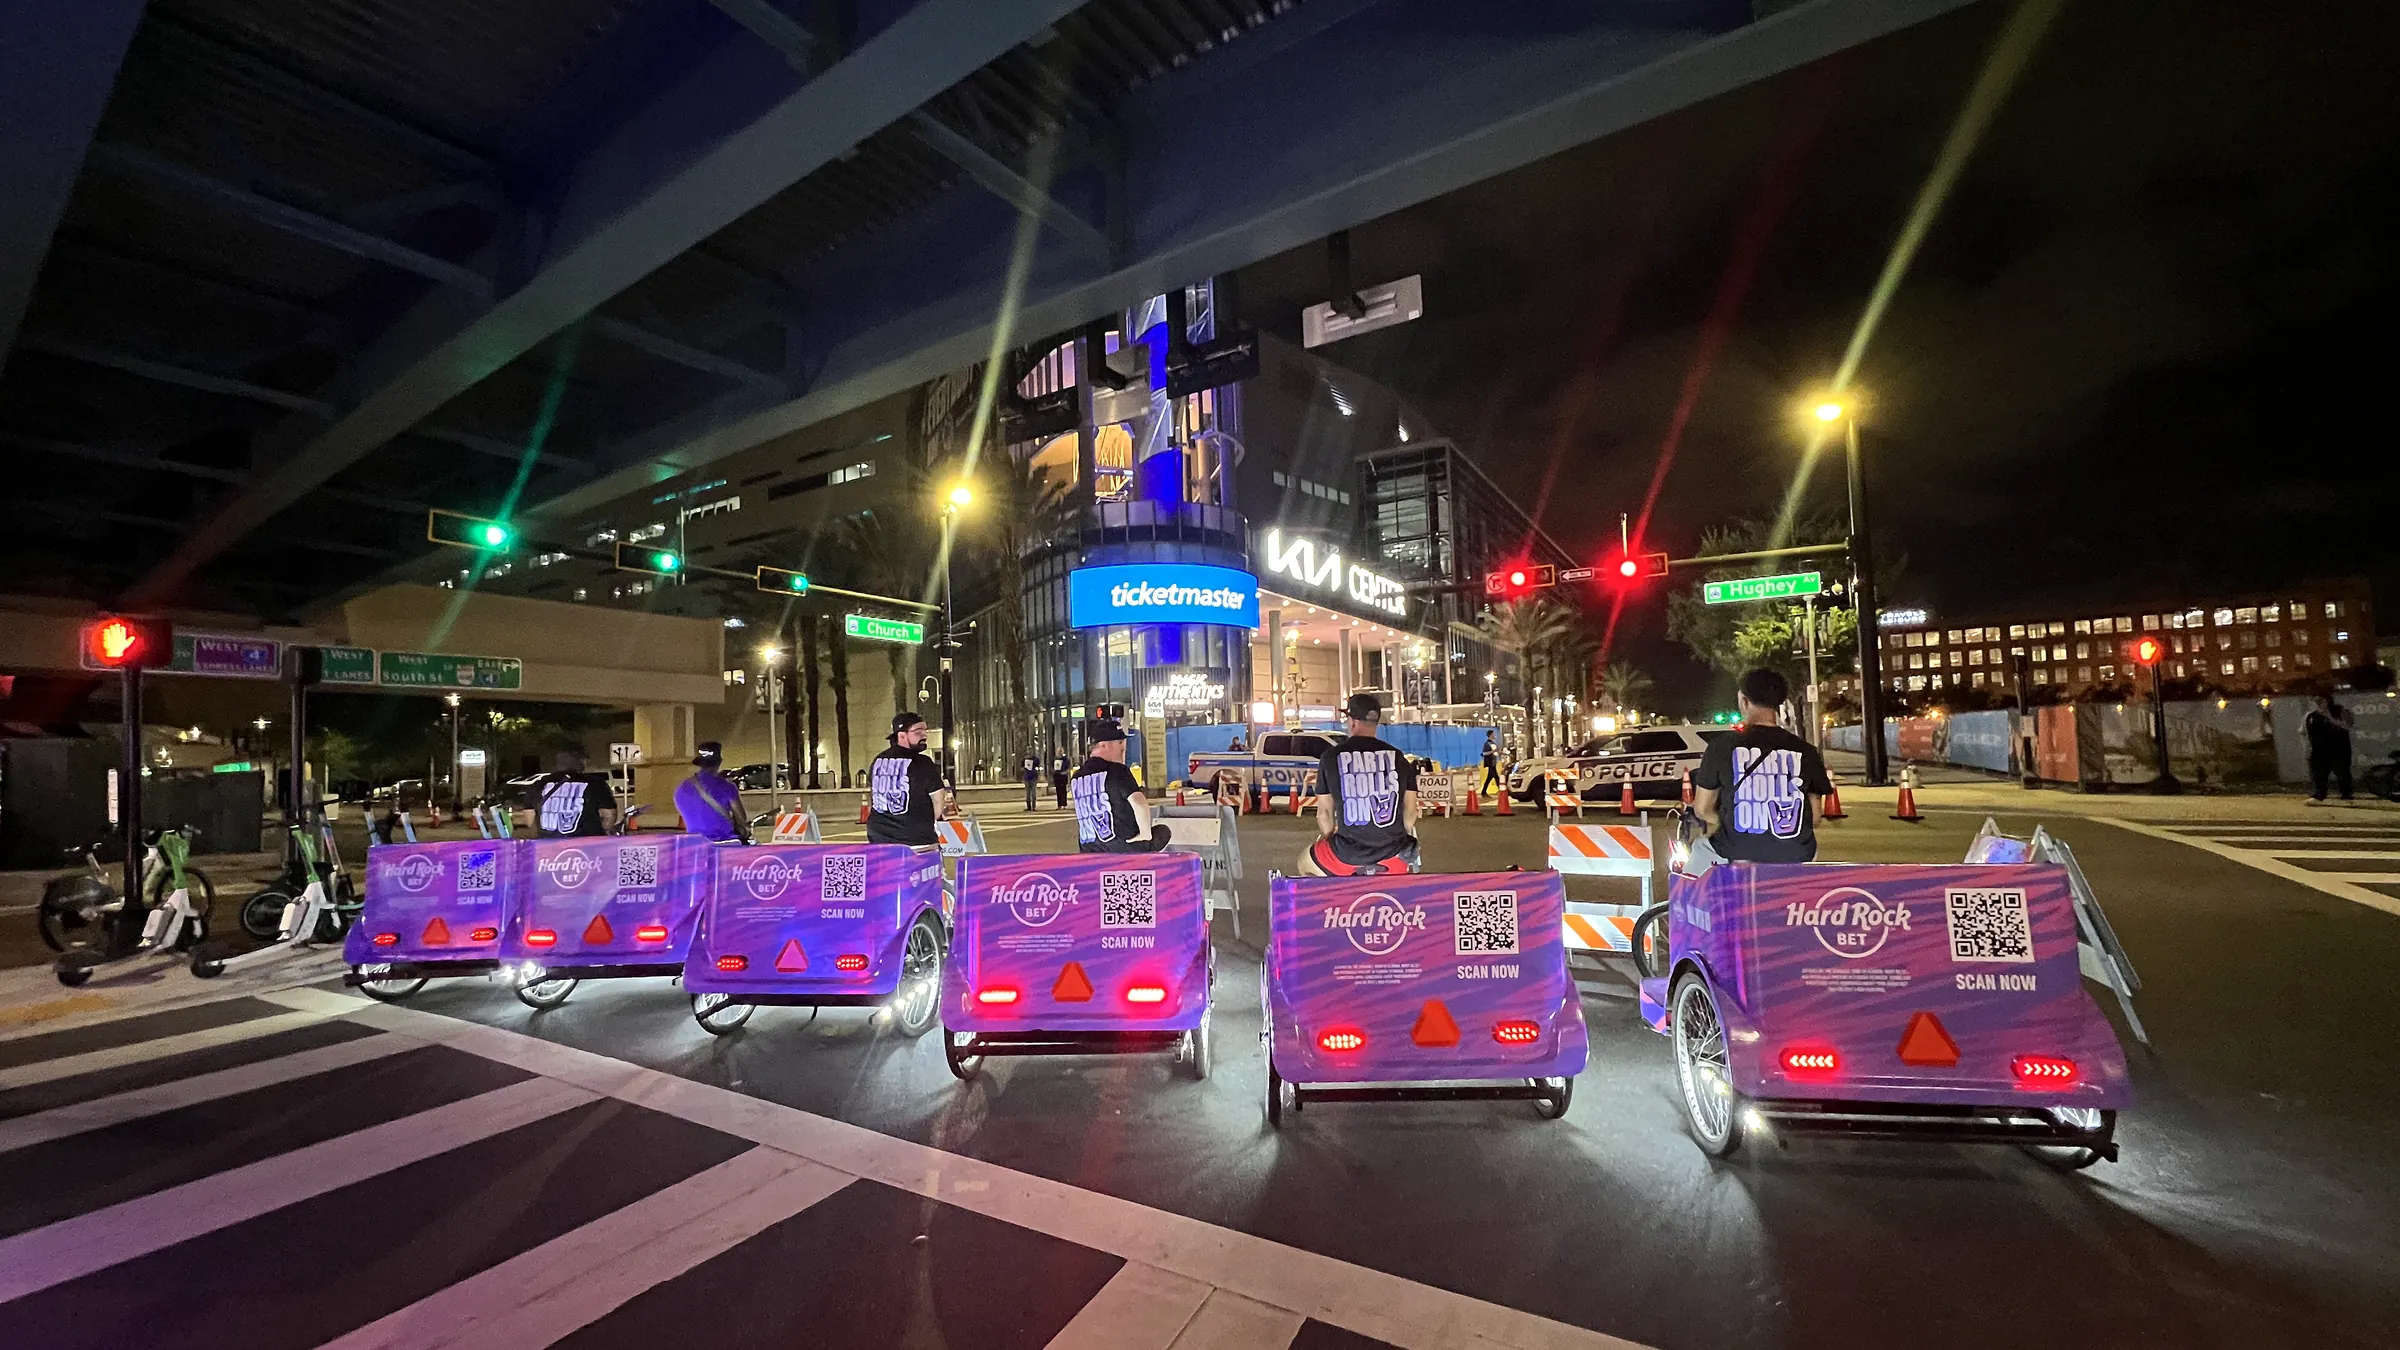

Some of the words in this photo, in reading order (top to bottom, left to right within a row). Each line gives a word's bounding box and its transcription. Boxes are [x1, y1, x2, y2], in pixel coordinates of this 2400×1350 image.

[1111, 581, 1245, 610] ticketmaster
[1349, 564, 1406, 616] CENTER
[1730, 580, 1797, 597] Hughey
[867, 621, 909, 638] Church
[383, 671, 426, 682] South
[873, 758, 912, 776] PARTY
[1337, 751, 1396, 774] PARTY
[1733, 747, 1803, 777] PARTY
[1599, 762, 1676, 780] POLICE
[1341, 771, 1399, 798] ROLLS
[1420, 777, 1448, 786] ROAD
[1735, 774, 1804, 803] ROLLS
[1416, 790, 1450, 799] CLOSED
[1343, 798, 1371, 826] ON
[1734, 801, 1770, 834] ON
[538, 857, 571, 873] Hard
[572, 856, 603, 873] Rock
[731, 865, 768, 881] Hard
[768, 864, 803, 882] Rock
[562, 874, 579, 883] BET
[758, 884, 776, 893] BET
[991, 885, 1036, 904] Hard
[1037, 883, 1080, 905] Rock
[616, 894, 636, 904] SCAN
[637, 893, 656, 903] NOW
[821, 908, 842, 919] SCAN
[844, 908, 864, 919] NOW
[1025, 907, 1048, 918] BET
[1323, 906, 1375, 928] Hard
[1377, 904, 1426, 931] Rock
[1786, 902, 1848, 926] Hard
[1851, 901, 1912, 931] Rock
[1101, 936, 1128, 949] SCAN
[1130, 936, 1155, 948] NOW
[1364, 933, 1390, 944] BET
[1836, 932, 1867, 945] BET
[1457, 965, 1489, 979] SCAN
[1491, 964, 1519, 979] NOW
[1955, 973, 1996, 990] SCAN
[2000, 974, 2037, 991] NOW
